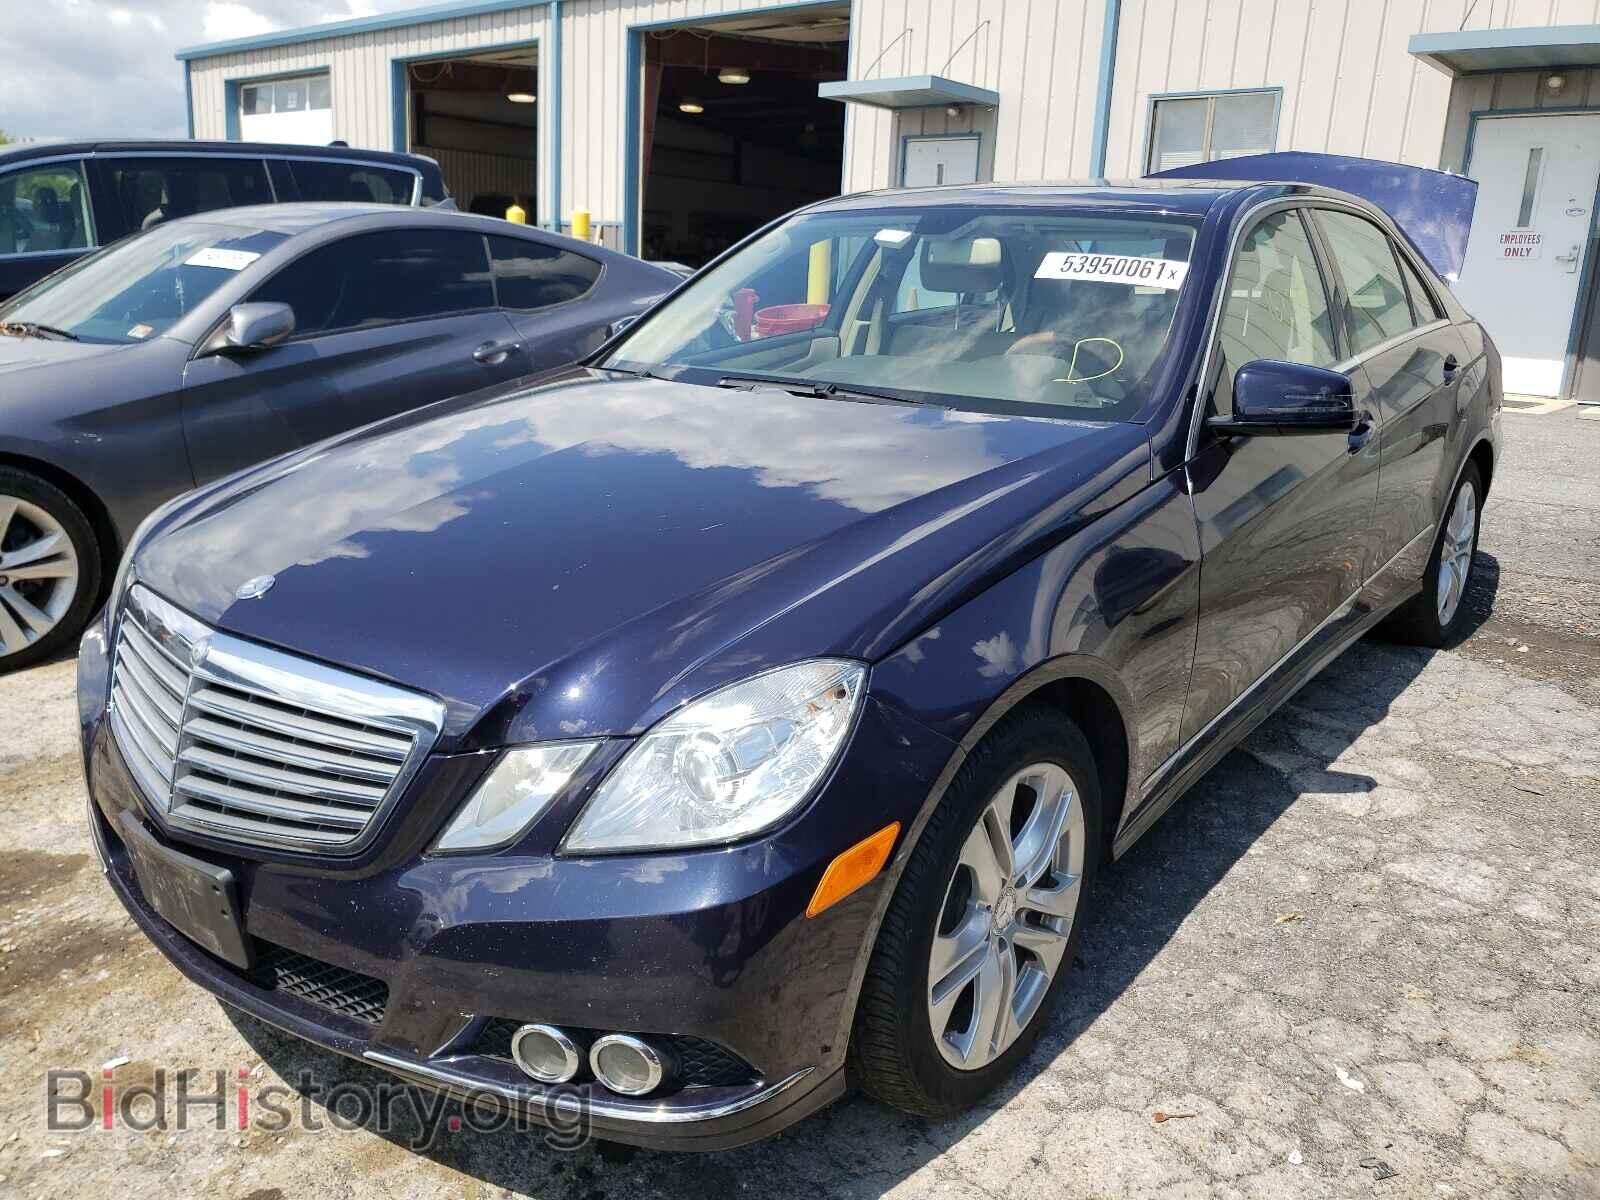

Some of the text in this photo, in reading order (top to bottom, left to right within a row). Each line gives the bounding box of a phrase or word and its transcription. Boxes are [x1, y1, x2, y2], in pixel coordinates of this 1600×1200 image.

[1499, 233, 1541, 245] EMPLOYEES
[1504, 247, 1532, 257] ONLY
[1052, 337, 1124, 384] D
